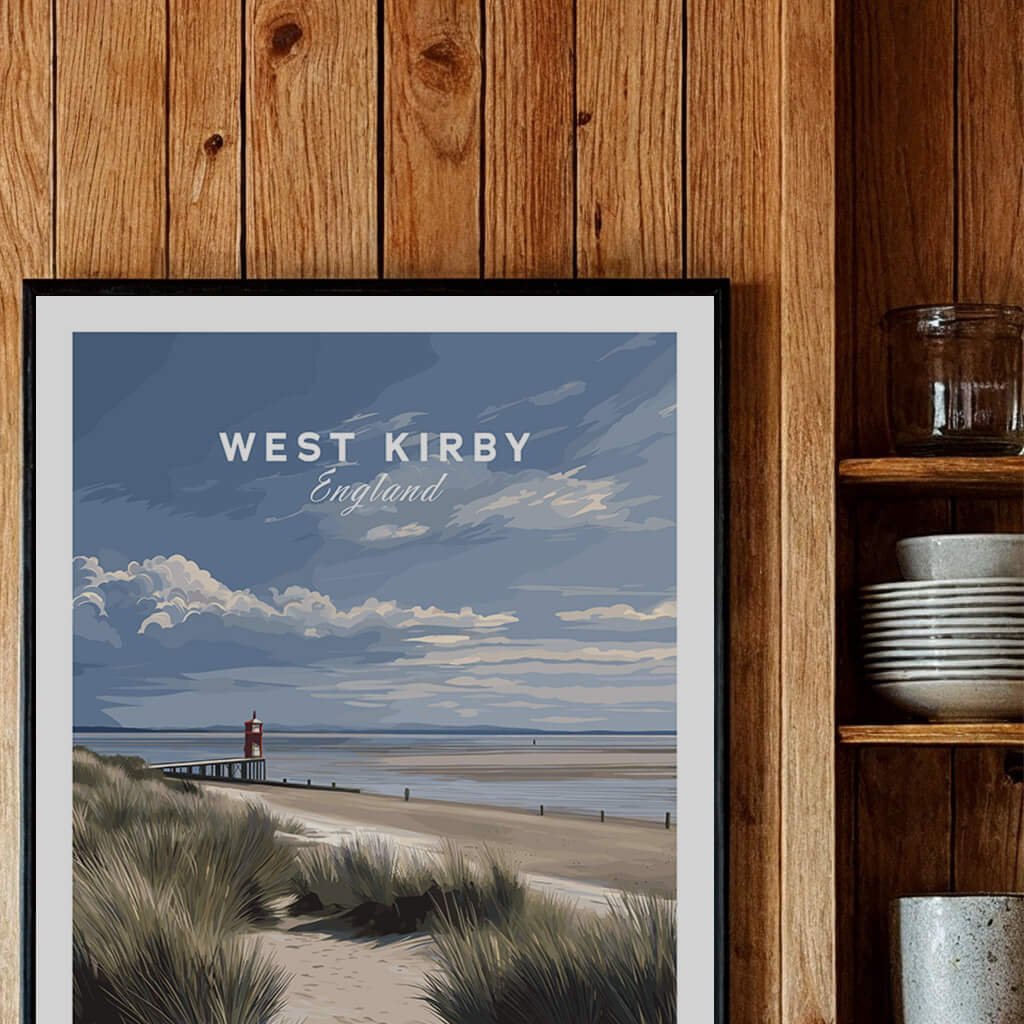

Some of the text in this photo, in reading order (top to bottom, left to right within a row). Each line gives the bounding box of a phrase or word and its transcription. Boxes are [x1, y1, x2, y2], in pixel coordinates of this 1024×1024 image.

[219, 432, 531, 462] WEST KIRBY
[309, 468, 448, 517] England
